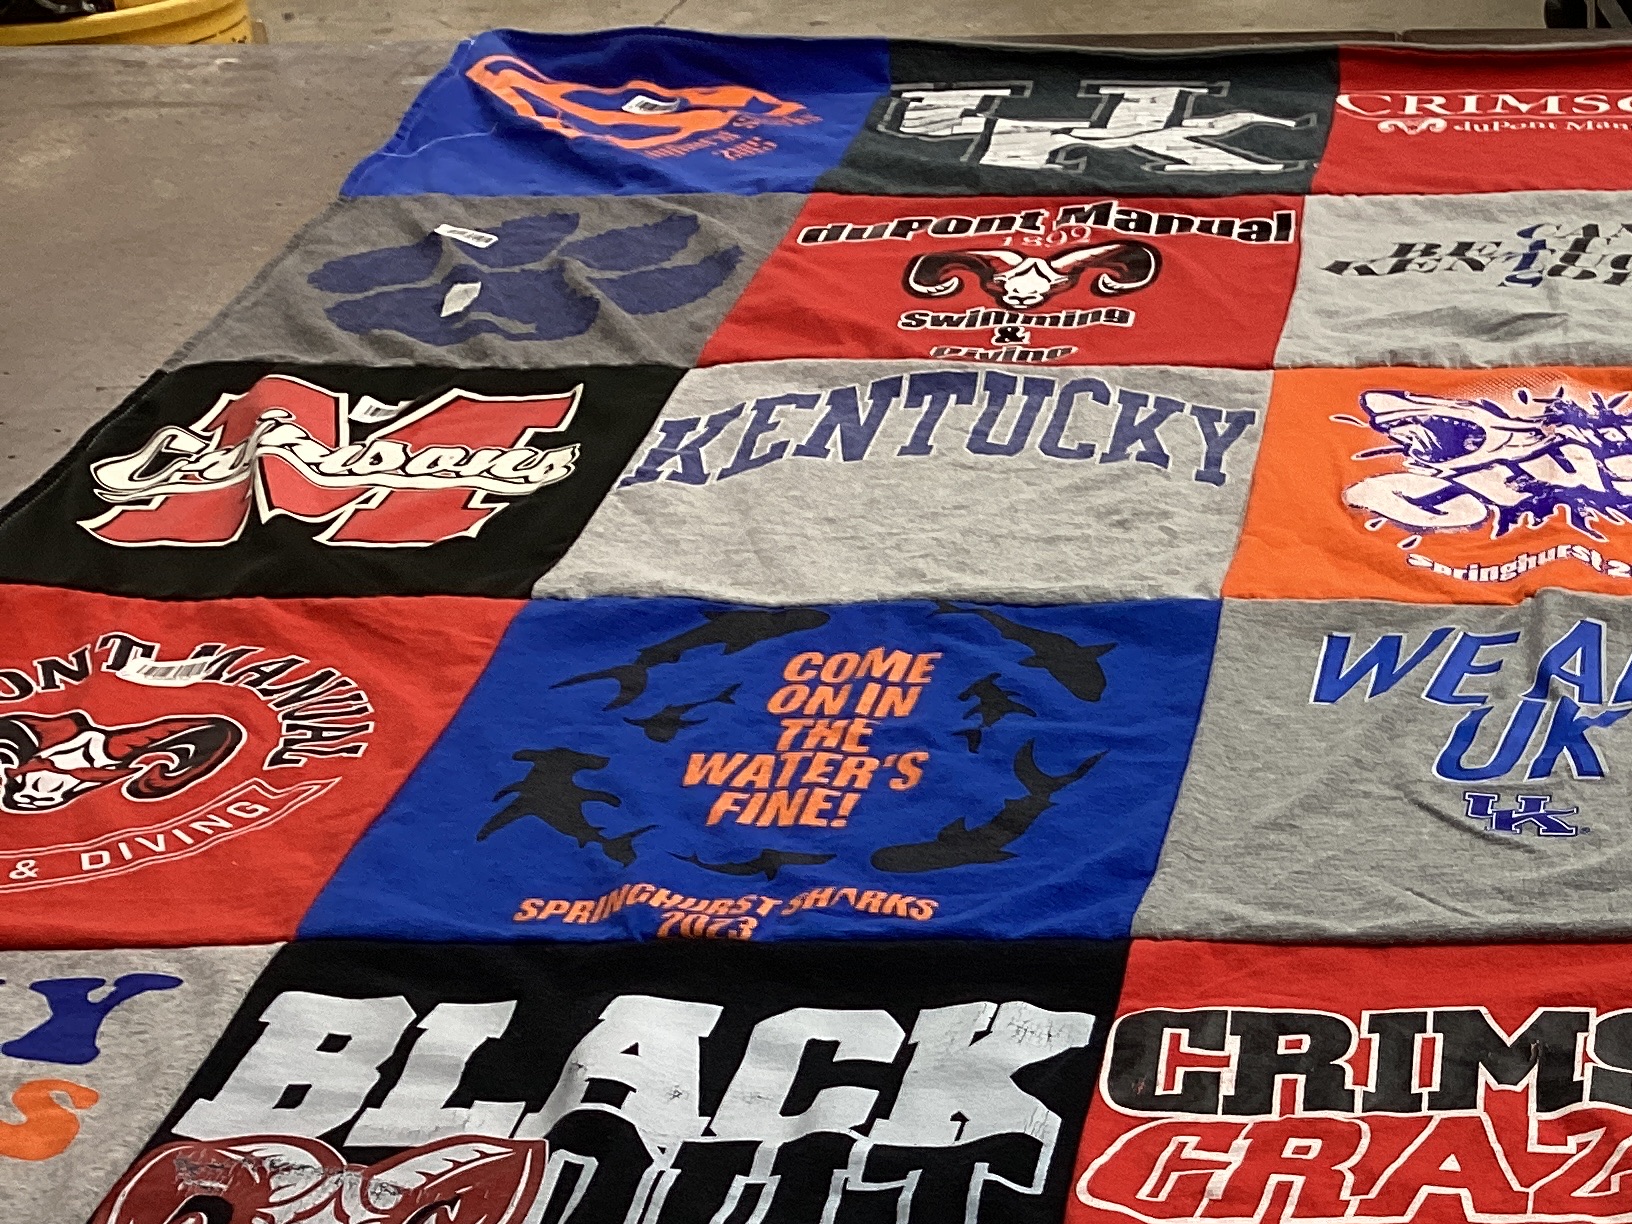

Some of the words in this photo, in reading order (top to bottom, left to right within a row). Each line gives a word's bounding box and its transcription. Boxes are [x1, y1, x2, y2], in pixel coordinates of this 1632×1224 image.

[1000, 225, 1092, 247] 1892
[1052, 199, 1297, 243] Manual
[897, 306, 1135, 330] Swimming
[991, 326, 1031, 346] &
[616, 369, 1260, 491] KENTUCKY
[1406, 543, 1604, 583] Springhurst
[782, 646, 943, 686] COME
[1309, 626, 1521, 706] WE
[767, 684, 850, 718] ON
[855, 684, 922, 718] IN
[775, 717, 872, 754] THE
[680, 750, 930, 793] WATER'S
[705, 787, 861, 828] FINE!
[9, 858, 40, 881] &
[81, 799, 270, 872] DIVING
[171, 990, 1096, 1148] BLACK
